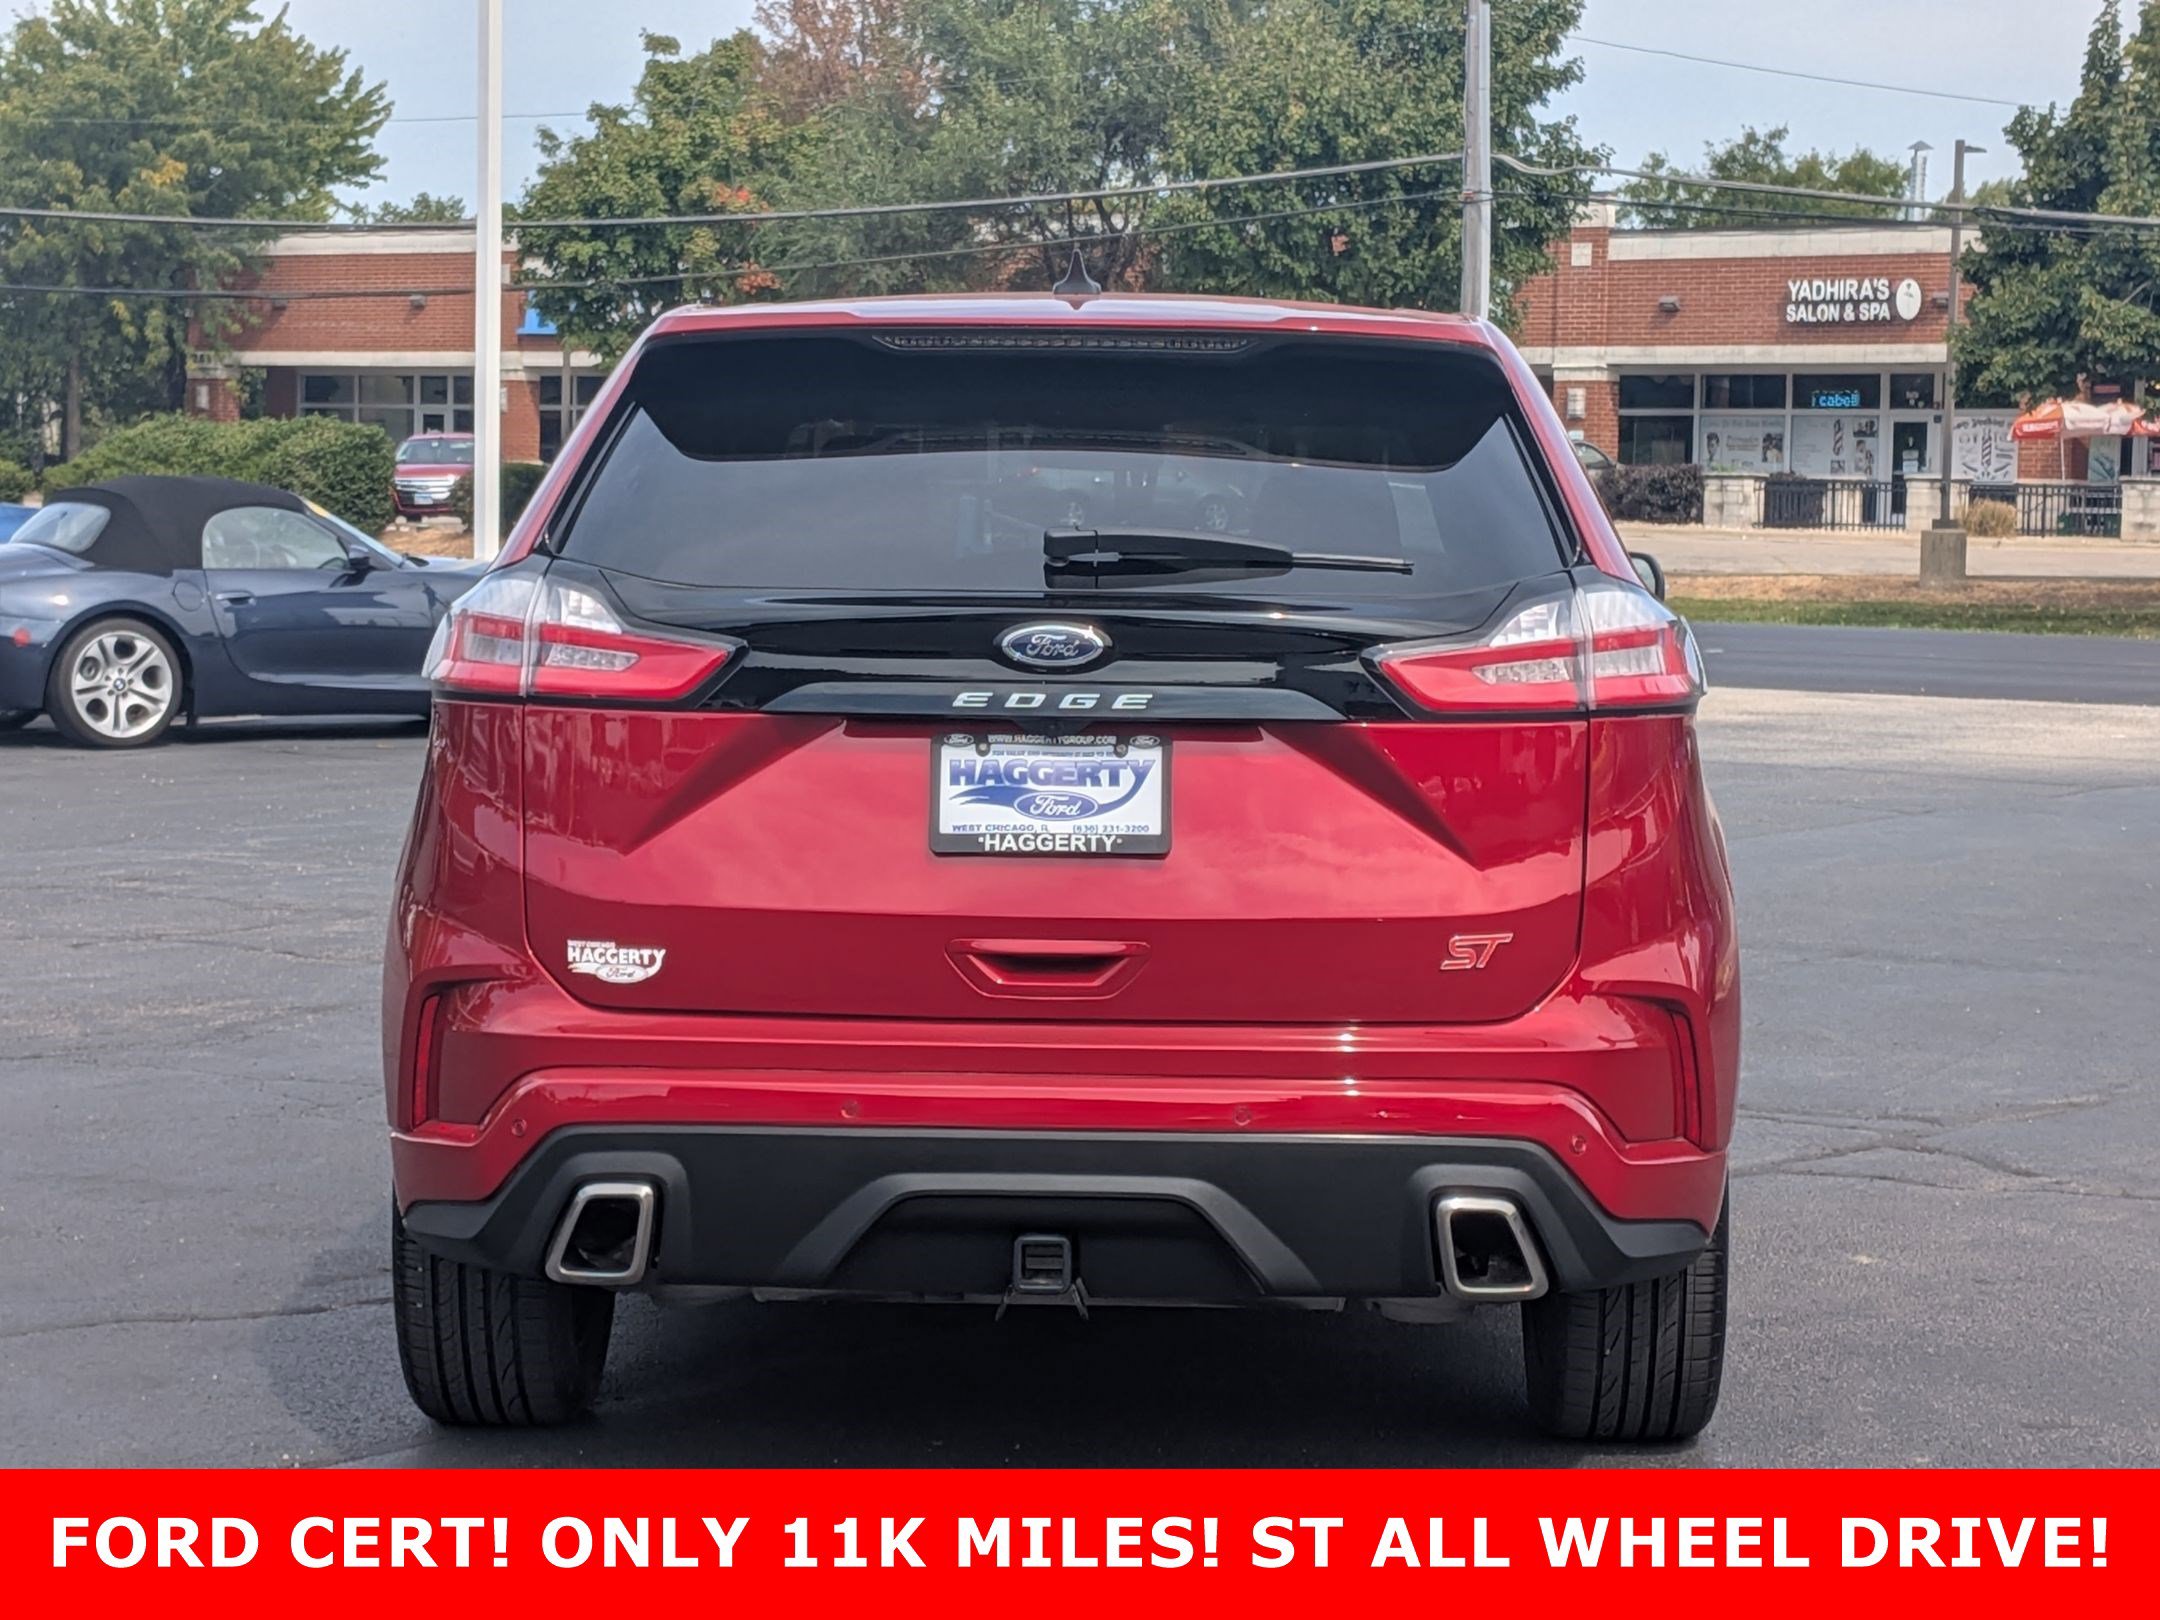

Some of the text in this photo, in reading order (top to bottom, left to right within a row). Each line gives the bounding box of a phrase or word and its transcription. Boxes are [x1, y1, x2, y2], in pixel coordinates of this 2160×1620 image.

[1787, 278, 1890, 302] YADHIRA'S
[1786, 302, 1891, 323] SALON & SPA
[1026, 633, 1080, 657] Ford
[952, 691, 1154, 710] EDGE
[949, 759, 1156, 789] HAGGERTY
[1029, 794, 1081, 816] Ford
[952, 824, 982, 832] WEST
[1102, 825, 1150, 833] 231-3200
[567, 947, 667, 965] HAGGERTY
[1440, 932, 1514, 970] ST
